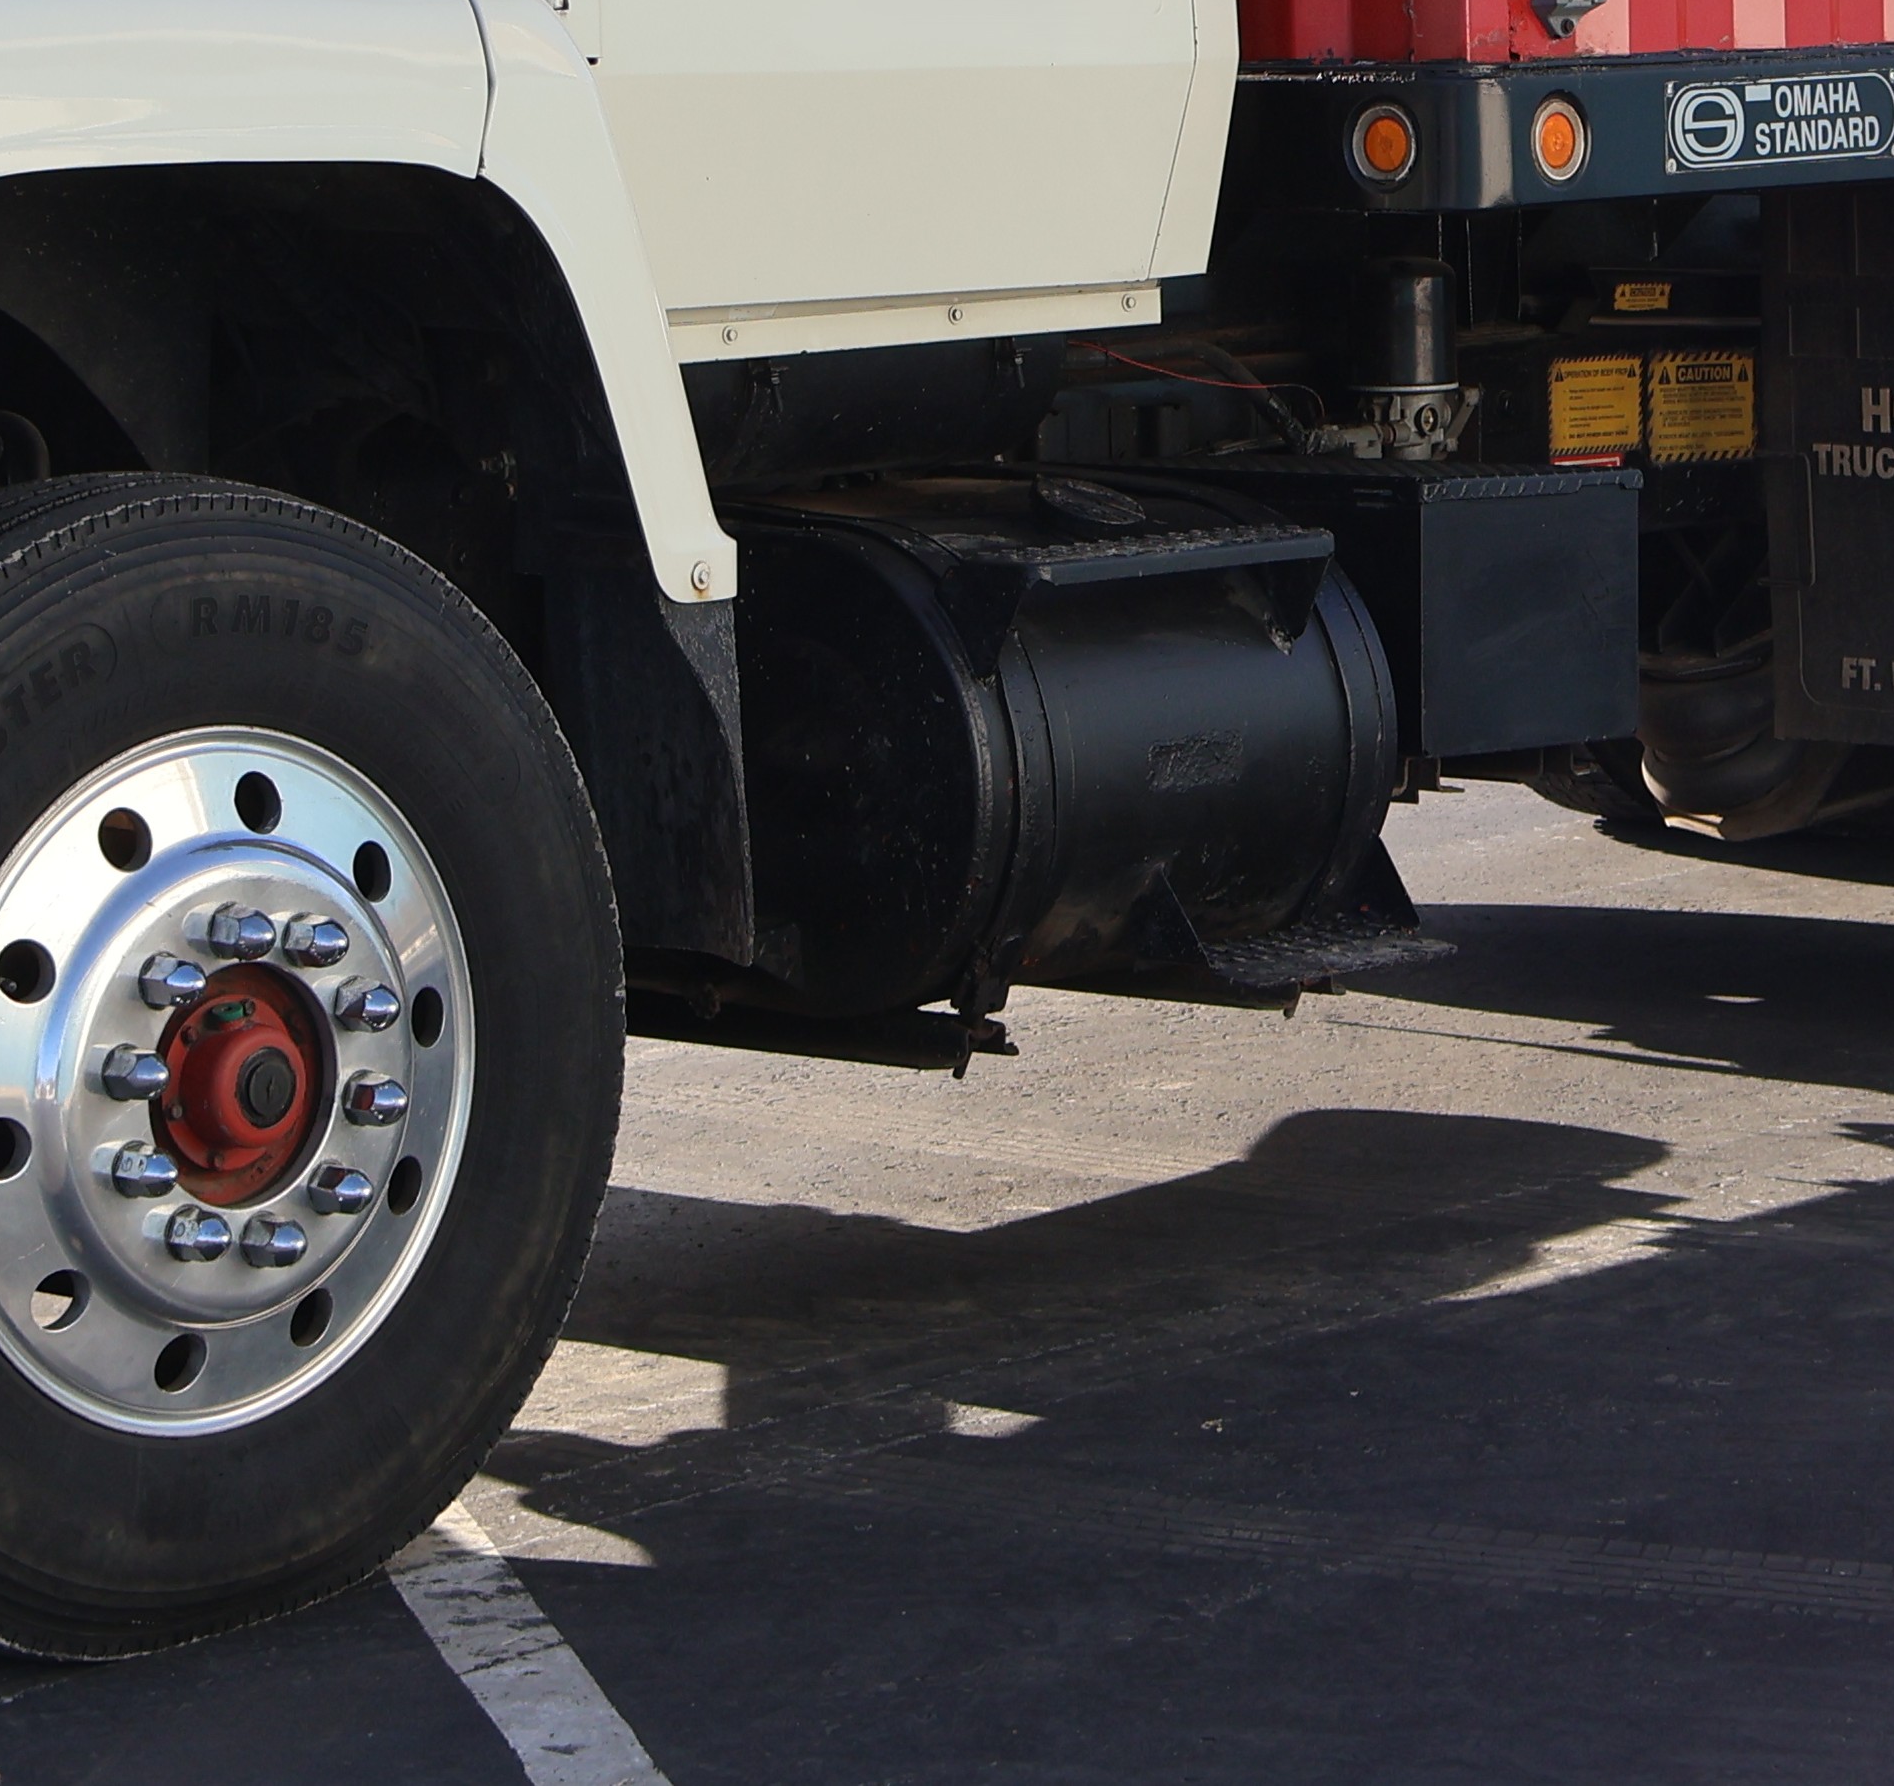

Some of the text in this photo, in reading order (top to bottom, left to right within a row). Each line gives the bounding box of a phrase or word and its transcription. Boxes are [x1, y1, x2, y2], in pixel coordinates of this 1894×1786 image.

[1775, 81, 1860, 118] OMAHA
[1755, 116, 1880, 156] STANDARD
[1678, 366, 1731, 382] CAUTION
[1842, 657, 1881, 691] FT.
